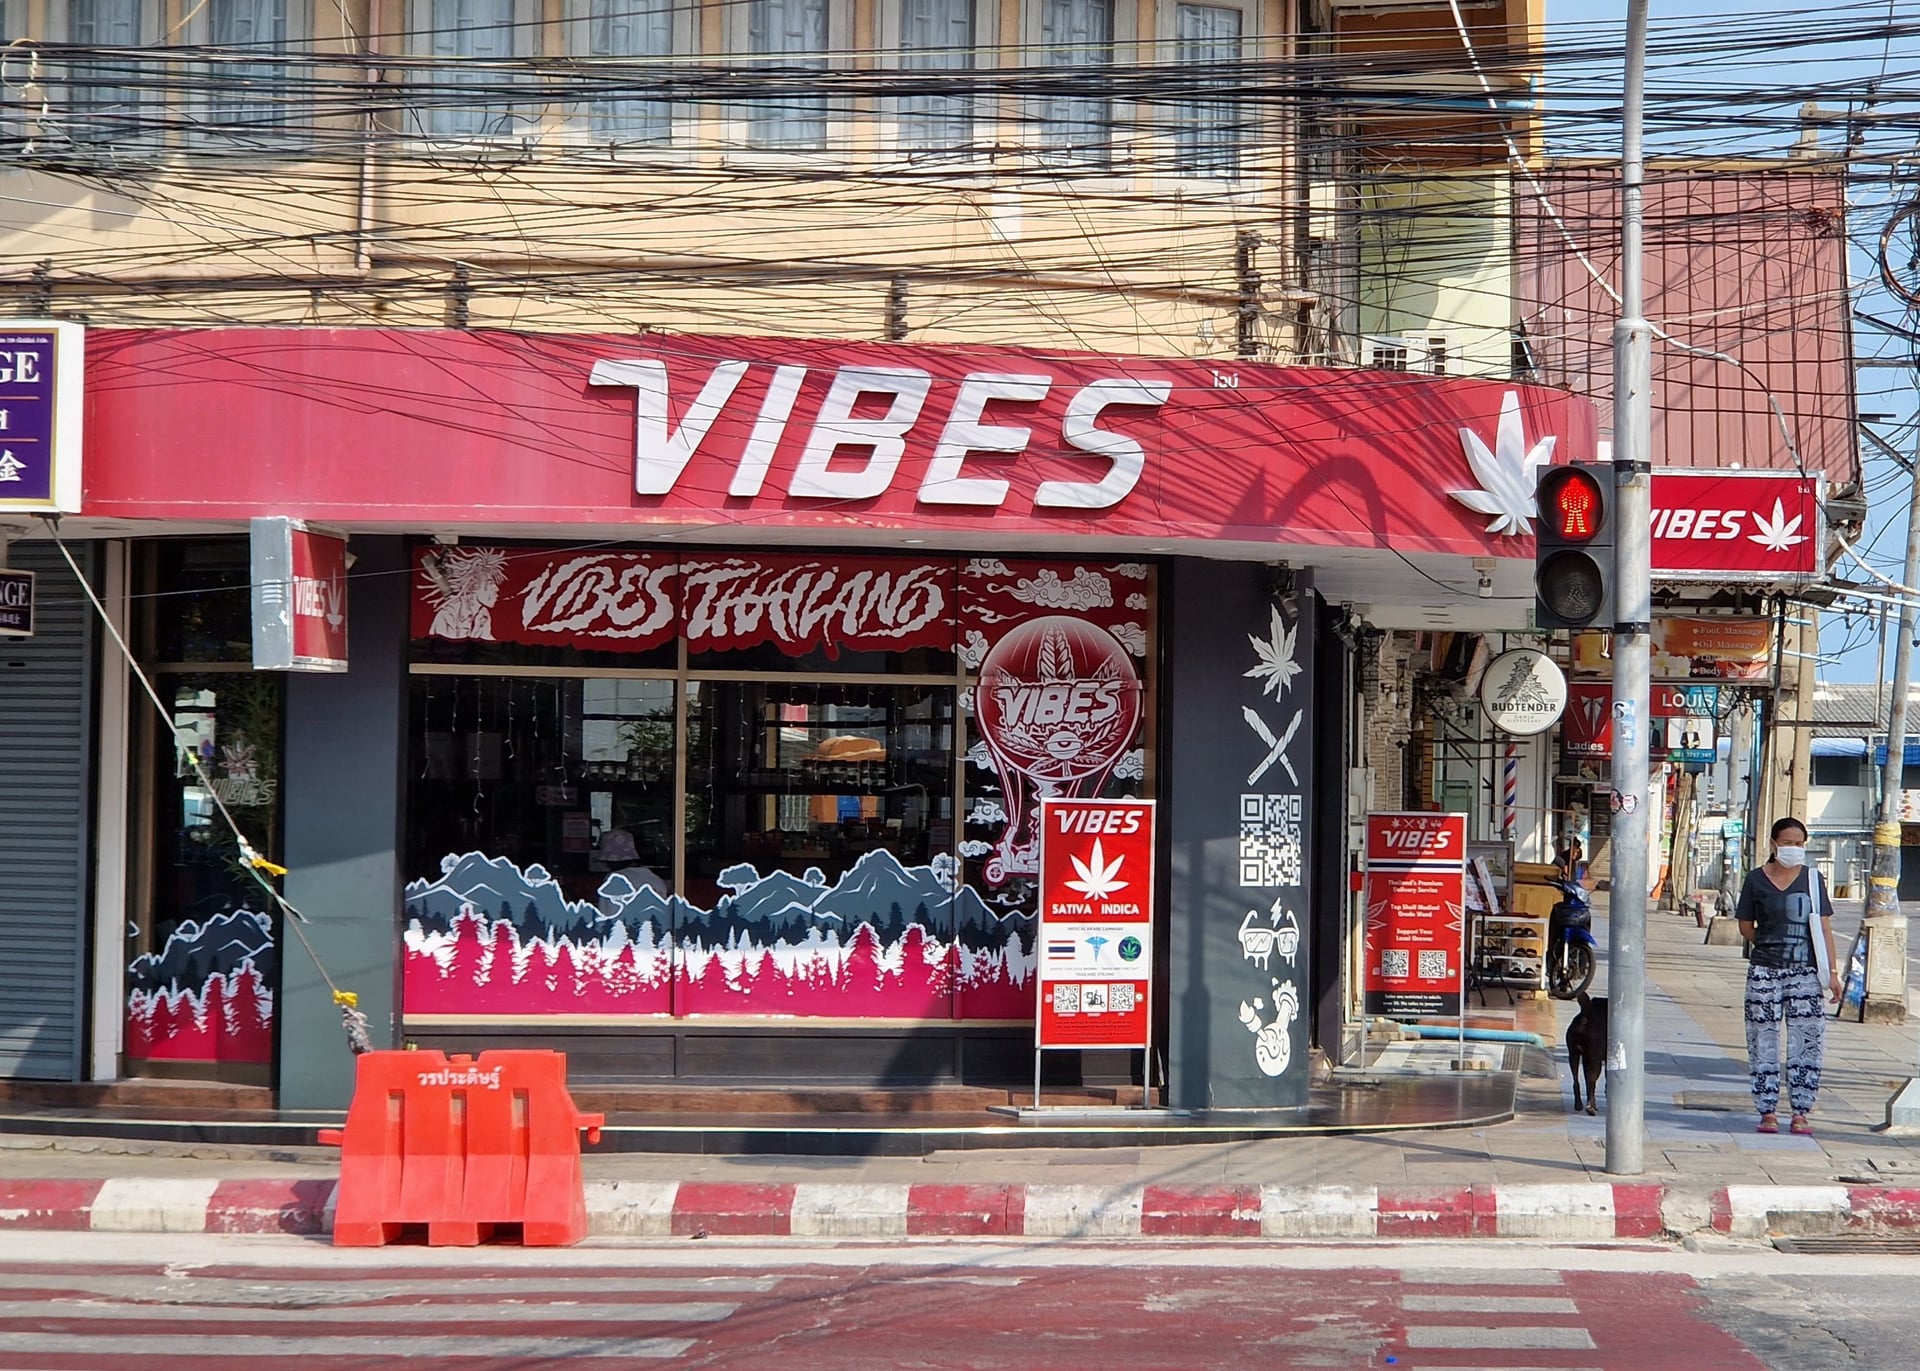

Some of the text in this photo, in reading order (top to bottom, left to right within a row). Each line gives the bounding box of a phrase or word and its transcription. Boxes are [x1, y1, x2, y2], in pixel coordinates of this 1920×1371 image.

[588, 360, 1173, 508] VIBES
[1651, 508, 1746, 540] IBES
[293, 575, 327, 618] VIBES
[512, 554, 955, 648] VIBES THAILAND
[1700, 626, 1763, 636] Foot Massage
[1700, 640, 1757, 650] Oil Massage
[1700, 667, 1722, 676] Body
[995, 681, 1125, 732] VIBES
[1491, 702, 1557, 712] BUDTENDER
[1662, 693, 1714, 708] LOUIS
[1567, 740, 1604, 751] Ladies
[1053, 810, 1144, 835] VIBES
[1381, 830, 1452, 849] VIBES
[1052, 903, 1140, 916] SATIVA INDICA
[417, 1065, 503, 1089] วรประดิษฐ์
